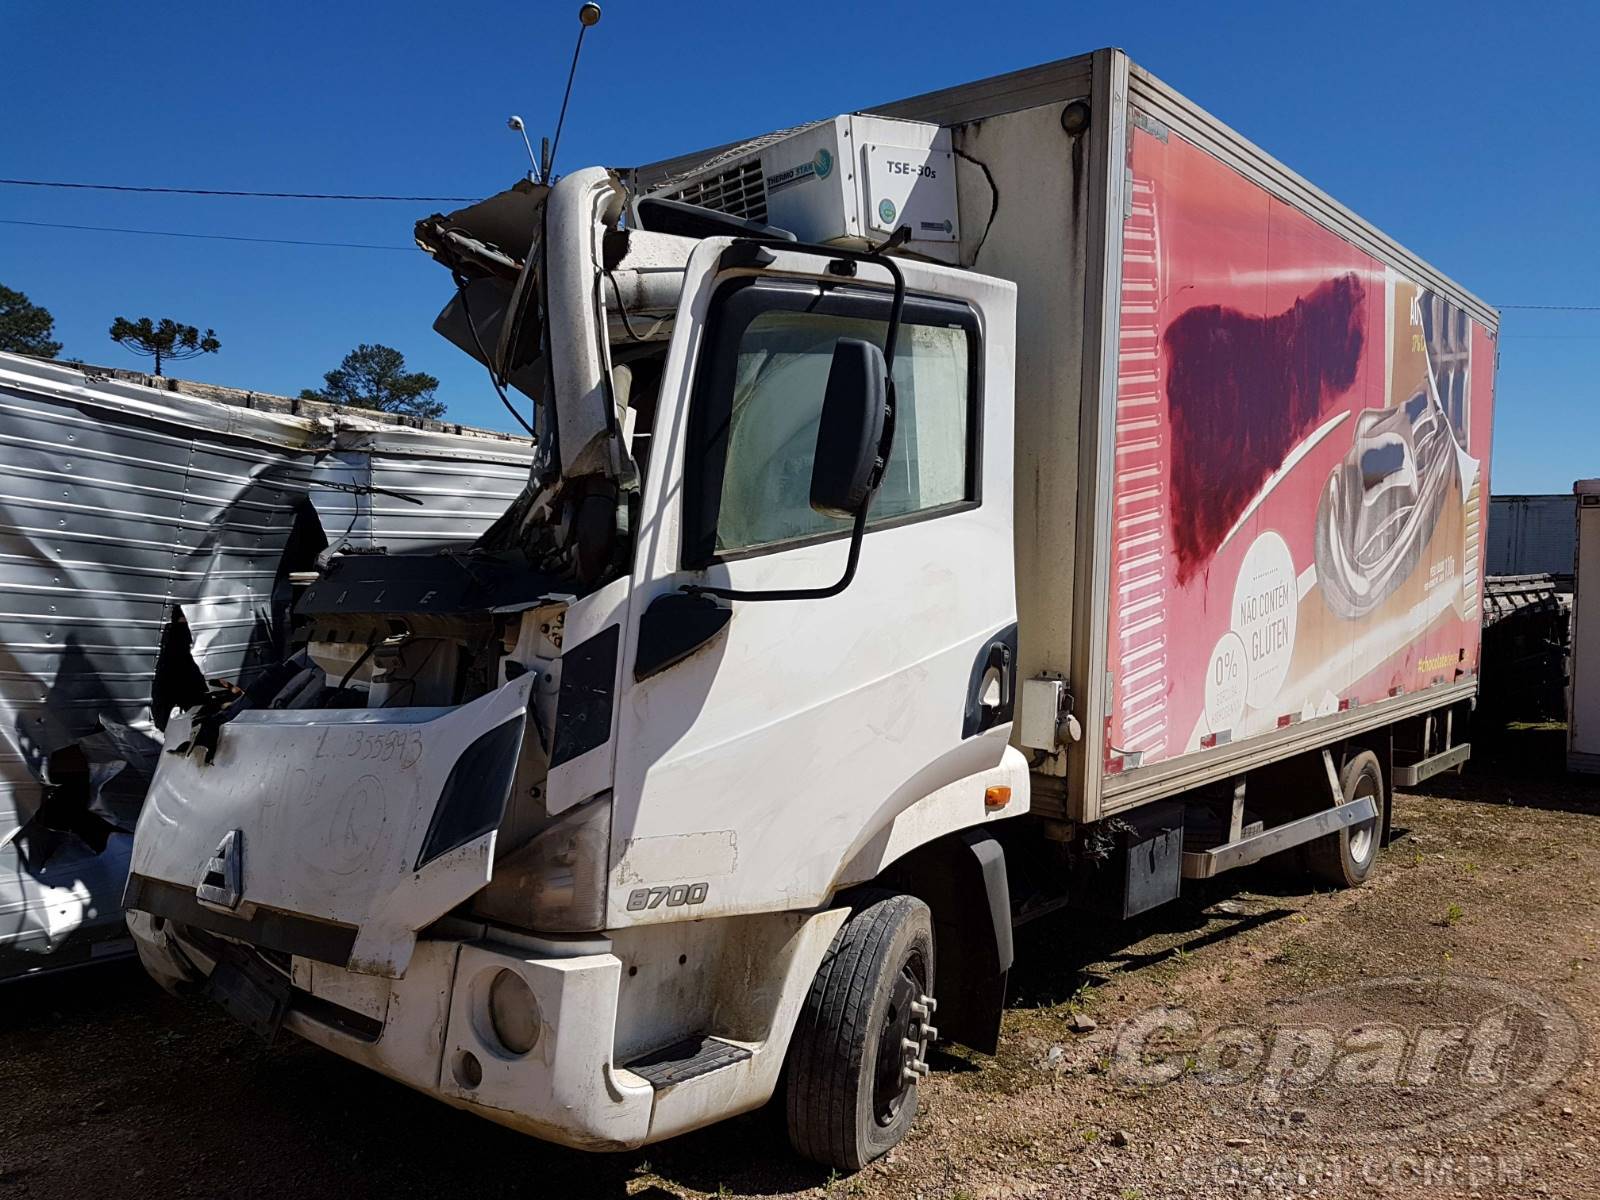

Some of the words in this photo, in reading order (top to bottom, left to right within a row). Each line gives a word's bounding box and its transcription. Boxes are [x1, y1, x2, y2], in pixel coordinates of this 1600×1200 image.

[767, 170, 794, 186] THERMO
[887, 160, 937, 179] TSE-30s
[1240, 595, 1257, 627] NÃO
[1259, 580, 1289, 617] CONTÉM
[1252, 616, 1289, 662] GLÚTEN
[1215, 650, 1238, 686] 0%
[626, 882, 709, 911] 8700
